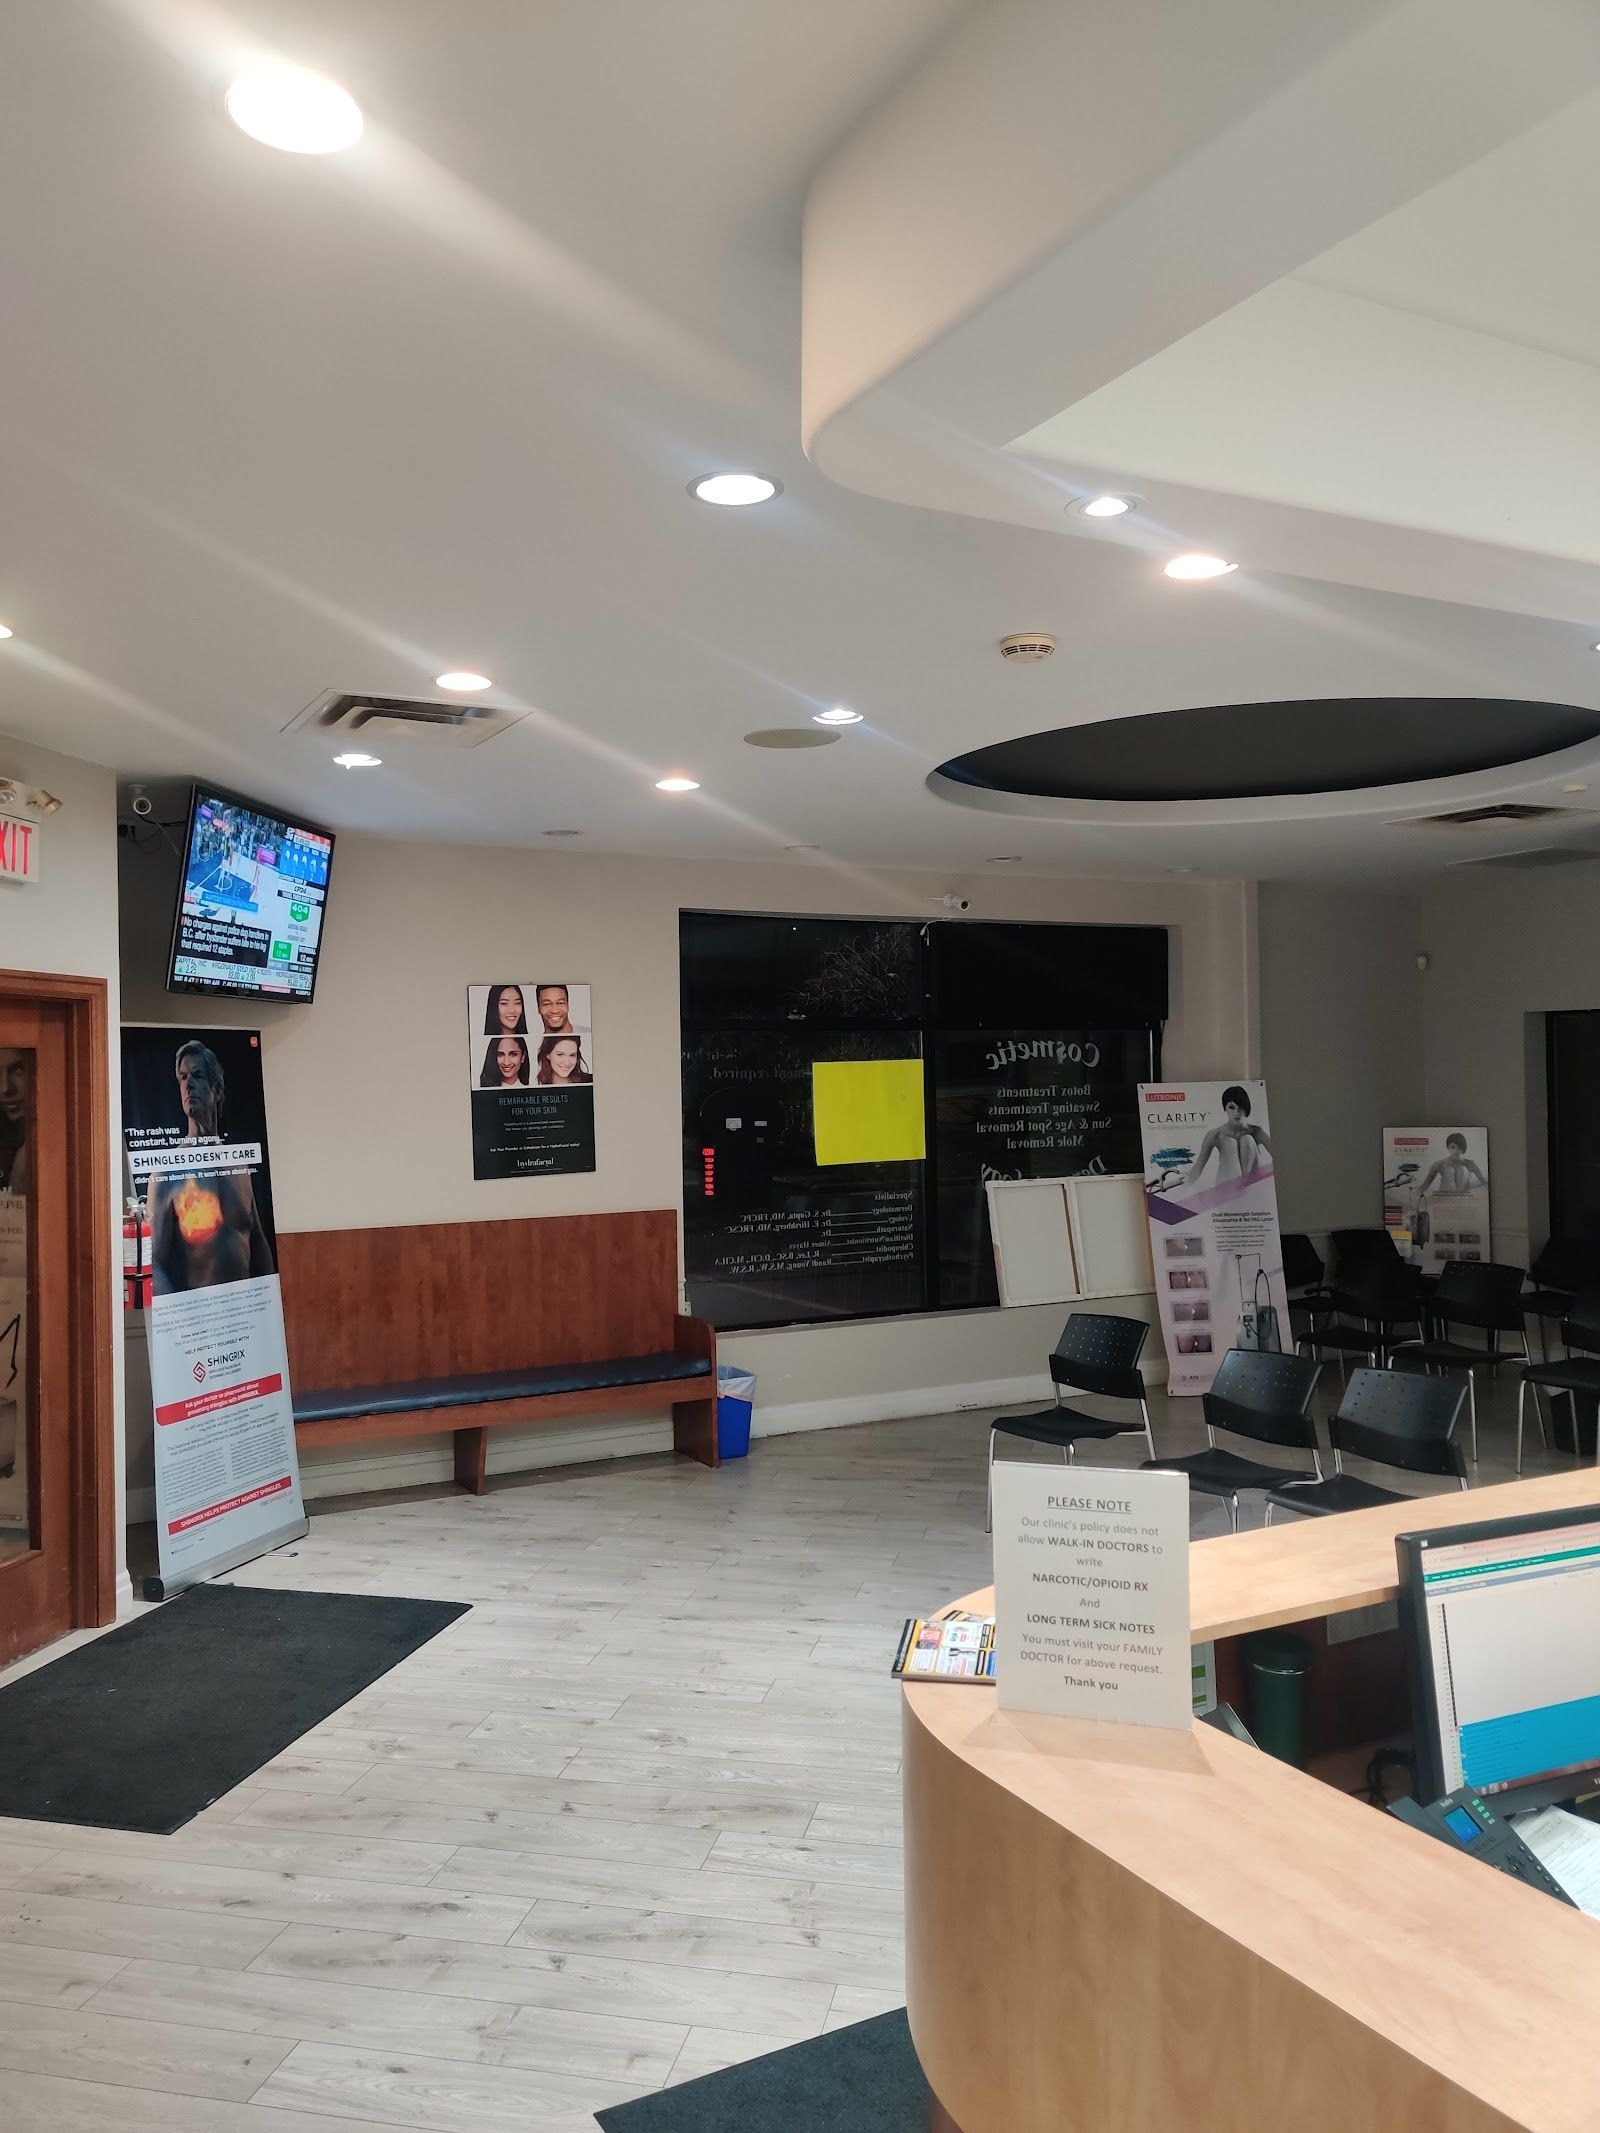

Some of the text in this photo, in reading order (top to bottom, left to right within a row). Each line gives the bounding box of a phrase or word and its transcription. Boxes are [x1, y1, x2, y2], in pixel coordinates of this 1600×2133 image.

[0, 821, 32, 875] XIT
[292, 903, 309, 913] 404
[182, 927, 195, 938] B.C.
[499, 1094, 569, 1106] REMARKABLE RESULTS
[1147, 1093, 1184, 1101] LUTRONIC
[512, 1106, 557, 1116] FOR YOUR SKIN
[1147, 1112, 1207, 1124] CLARITY
[146, 1126, 164, 1136] rash
[165, 1127, 180, 1135] was
[129, 1137, 169, 1148] constant,
[169, 1135, 197, 1146] burning
[134, 1149, 256, 1168] SHINGLES DOESN'T CARE
[207, 1348, 246, 1367] SHINGRIX
[1047, 1496, 1132, 1512] PLEASE NOTE
[1021, 1516, 1159, 1537] Our clinic's policy does not
[1018, 1534, 1163, 1555] allow WALK-IN DOCTORS to
[1076, 1556, 1103, 1568] write
[1032, 1572, 1149, 1592] NARCOTIC/OPIOID RX
[1079, 1597, 1101, 1609] And
[1027, 1613, 1156, 1635] LONG TERM SICK NOTES
[1022, 1632, 1164, 1656] You must visit your FAMILY
[1020, 1650, 1164, 1675] DOCTOR for above request.
[1063, 1675, 1119, 1691] Thank you
